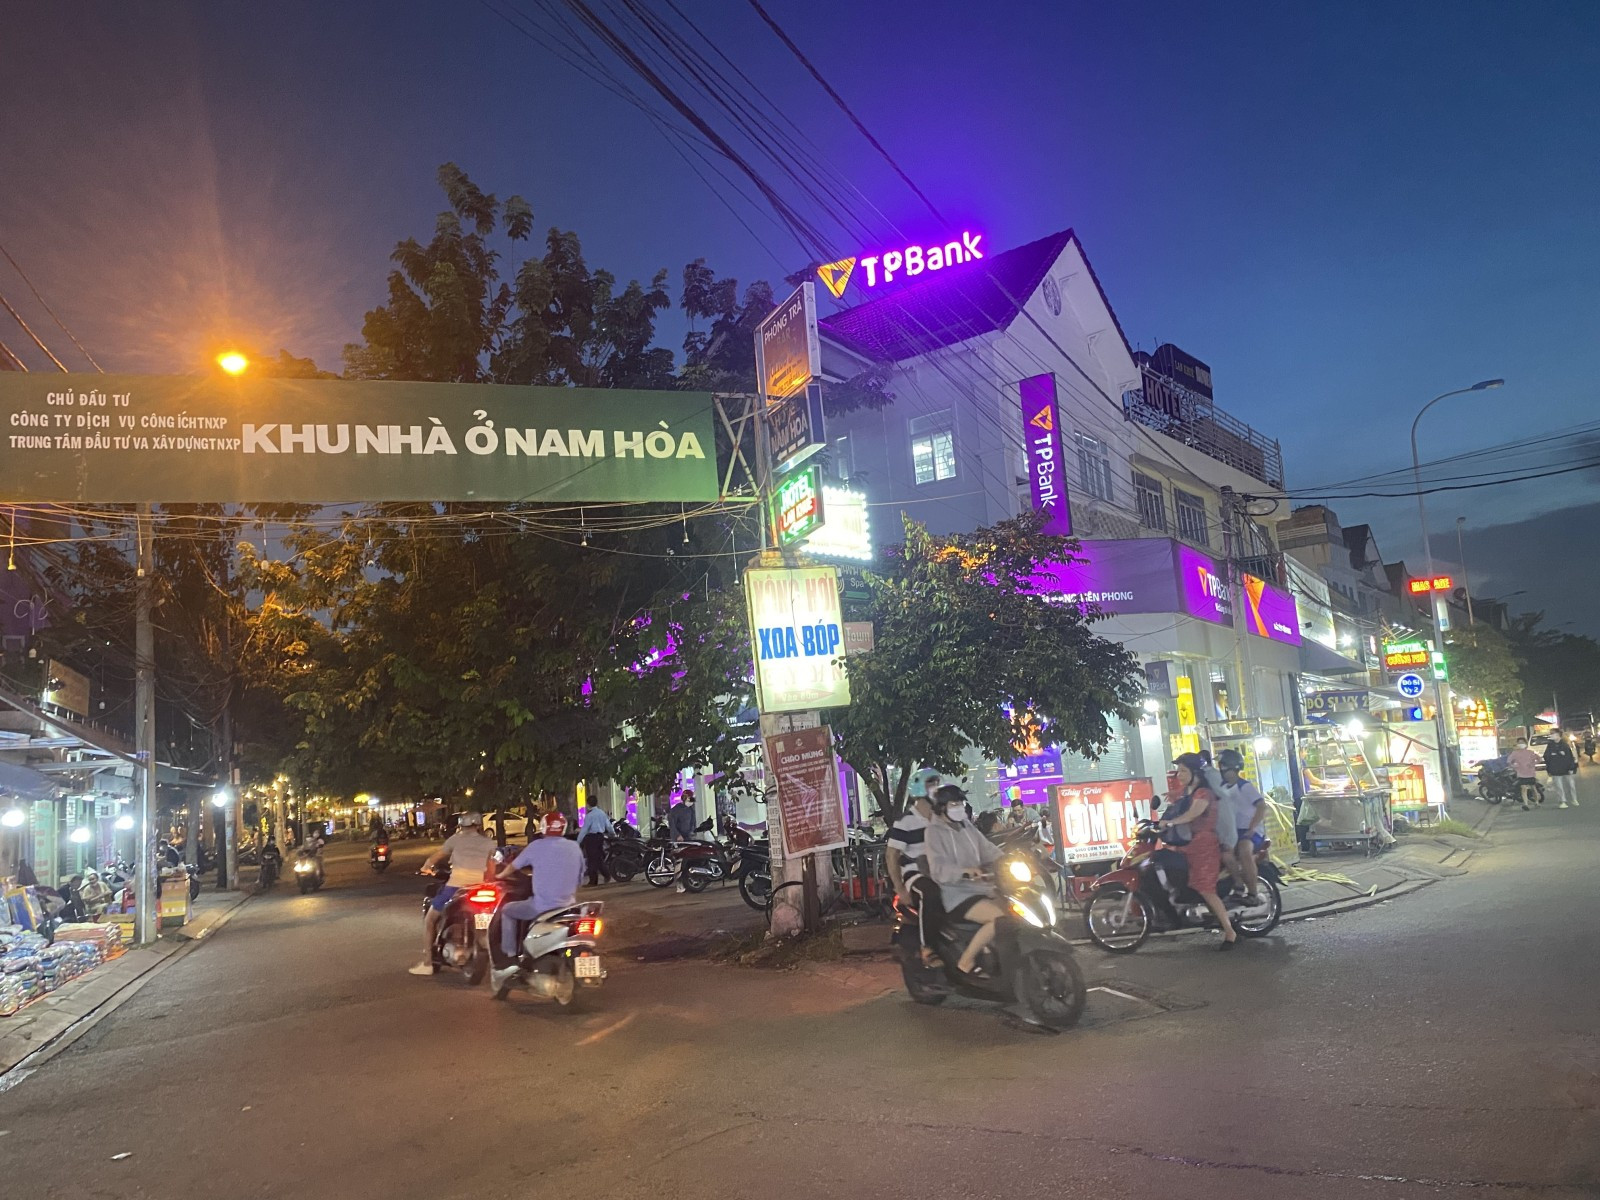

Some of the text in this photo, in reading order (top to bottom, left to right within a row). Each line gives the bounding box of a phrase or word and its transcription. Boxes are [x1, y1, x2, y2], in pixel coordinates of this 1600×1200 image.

[860, 231, 983, 287] TPBank
[46, 388, 131, 406] CHỦ ĐẦU TƯ
[10, 410, 49, 427] CÔNG
[54, 414, 72, 427] TY
[77, 411, 110, 430] DỊCH
[119, 415, 136, 430] VỤ
[141, 412, 175, 428] CÔNG
[242, 409, 706, 459] KHU NHÀ Ở NAM HÒA
[9, 435, 51, 449] TRUNG
[54, 432, 82, 449] TÂM
[85, 431, 111, 449] ĐẦU
[113, 434, 131, 449] TƯ
[1034, 432, 1059, 508] TPBank
[805, 572, 837, 612] HƠI
[850, 577, 865, 589] Spa
[1101, 591, 1134, 602] PHONG
[1206, 572, 1231, 602] TPBan
[758, 619, 840, 660] XOA BÓP
[845, 626, 870, 643] Town
[1064, 795, 1108, 845] CƠM
